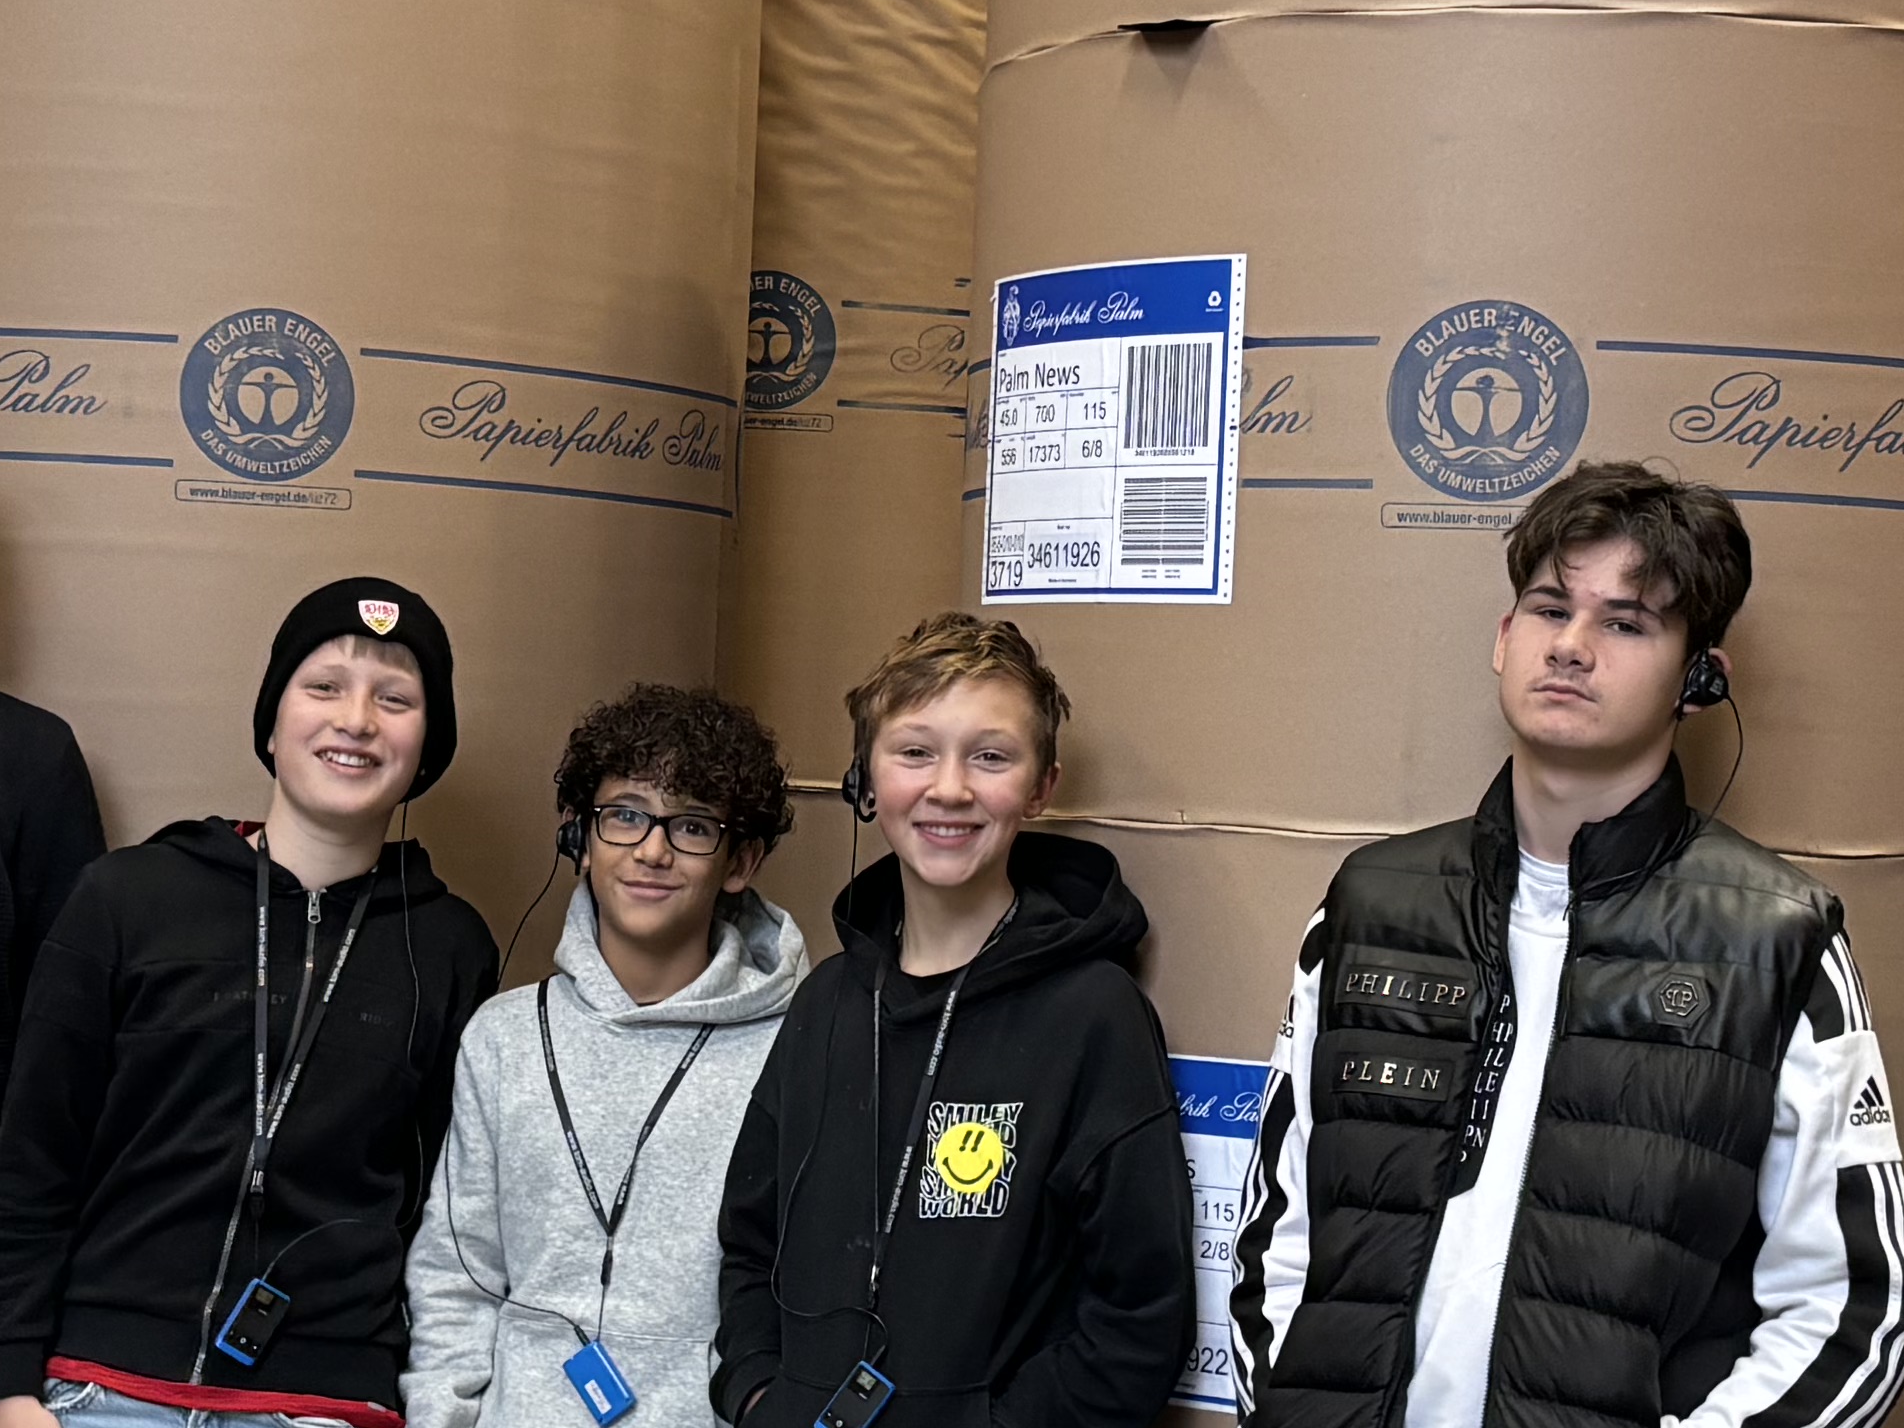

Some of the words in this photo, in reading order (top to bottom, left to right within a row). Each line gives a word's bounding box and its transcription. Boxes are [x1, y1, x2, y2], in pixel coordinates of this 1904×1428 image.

[779, 278, 821, 317] ENGEL
[1097, 291, 1145, 323] Palm
[204, 315, 276, 356] BLAUER
[284, 318, 337, 367] ENGEL
[1414, 308, 1496, 357] BLAUER
[1505, 311, 1570, 367] ENGEL
[999, 366, 1029, 394] Palm
[1034, 361, 1081, 389] News
[419, 380, 656, 465] Papierfabrik
[662, 409, 723, 471] Palm
[1000, 406, 1018, 427] 45.0
[1035, 403, 1056, 424] 700
[1083, 401, 1107, 421] 115
[201, 429, 224, 456] DAS
[225, 435, 332, 475] UMWELTZEICHEN
[1001, 445, 1017, 466] 556
[1028, 443, 1061, 465] 17373
[1082, 439, 1103, 459] 6/8
[1409, 445, 1438, 475] DAS
[1439, 446, 1561, 495] UMWELTZEICHEN
[1396, 509, 1524, 527] www.blauer-engel.
[1027, 541, 1101, 569] 34611926
[990, 560, 1023, 588] 3719
[1345, 972, 1466, 1006] PHILIPP
[1342, 1059, 1440, 1091] PLEIN
[1201, 1200, 1234, 1222] 115
[1201, 1239, 1230, 1261] 2/8
